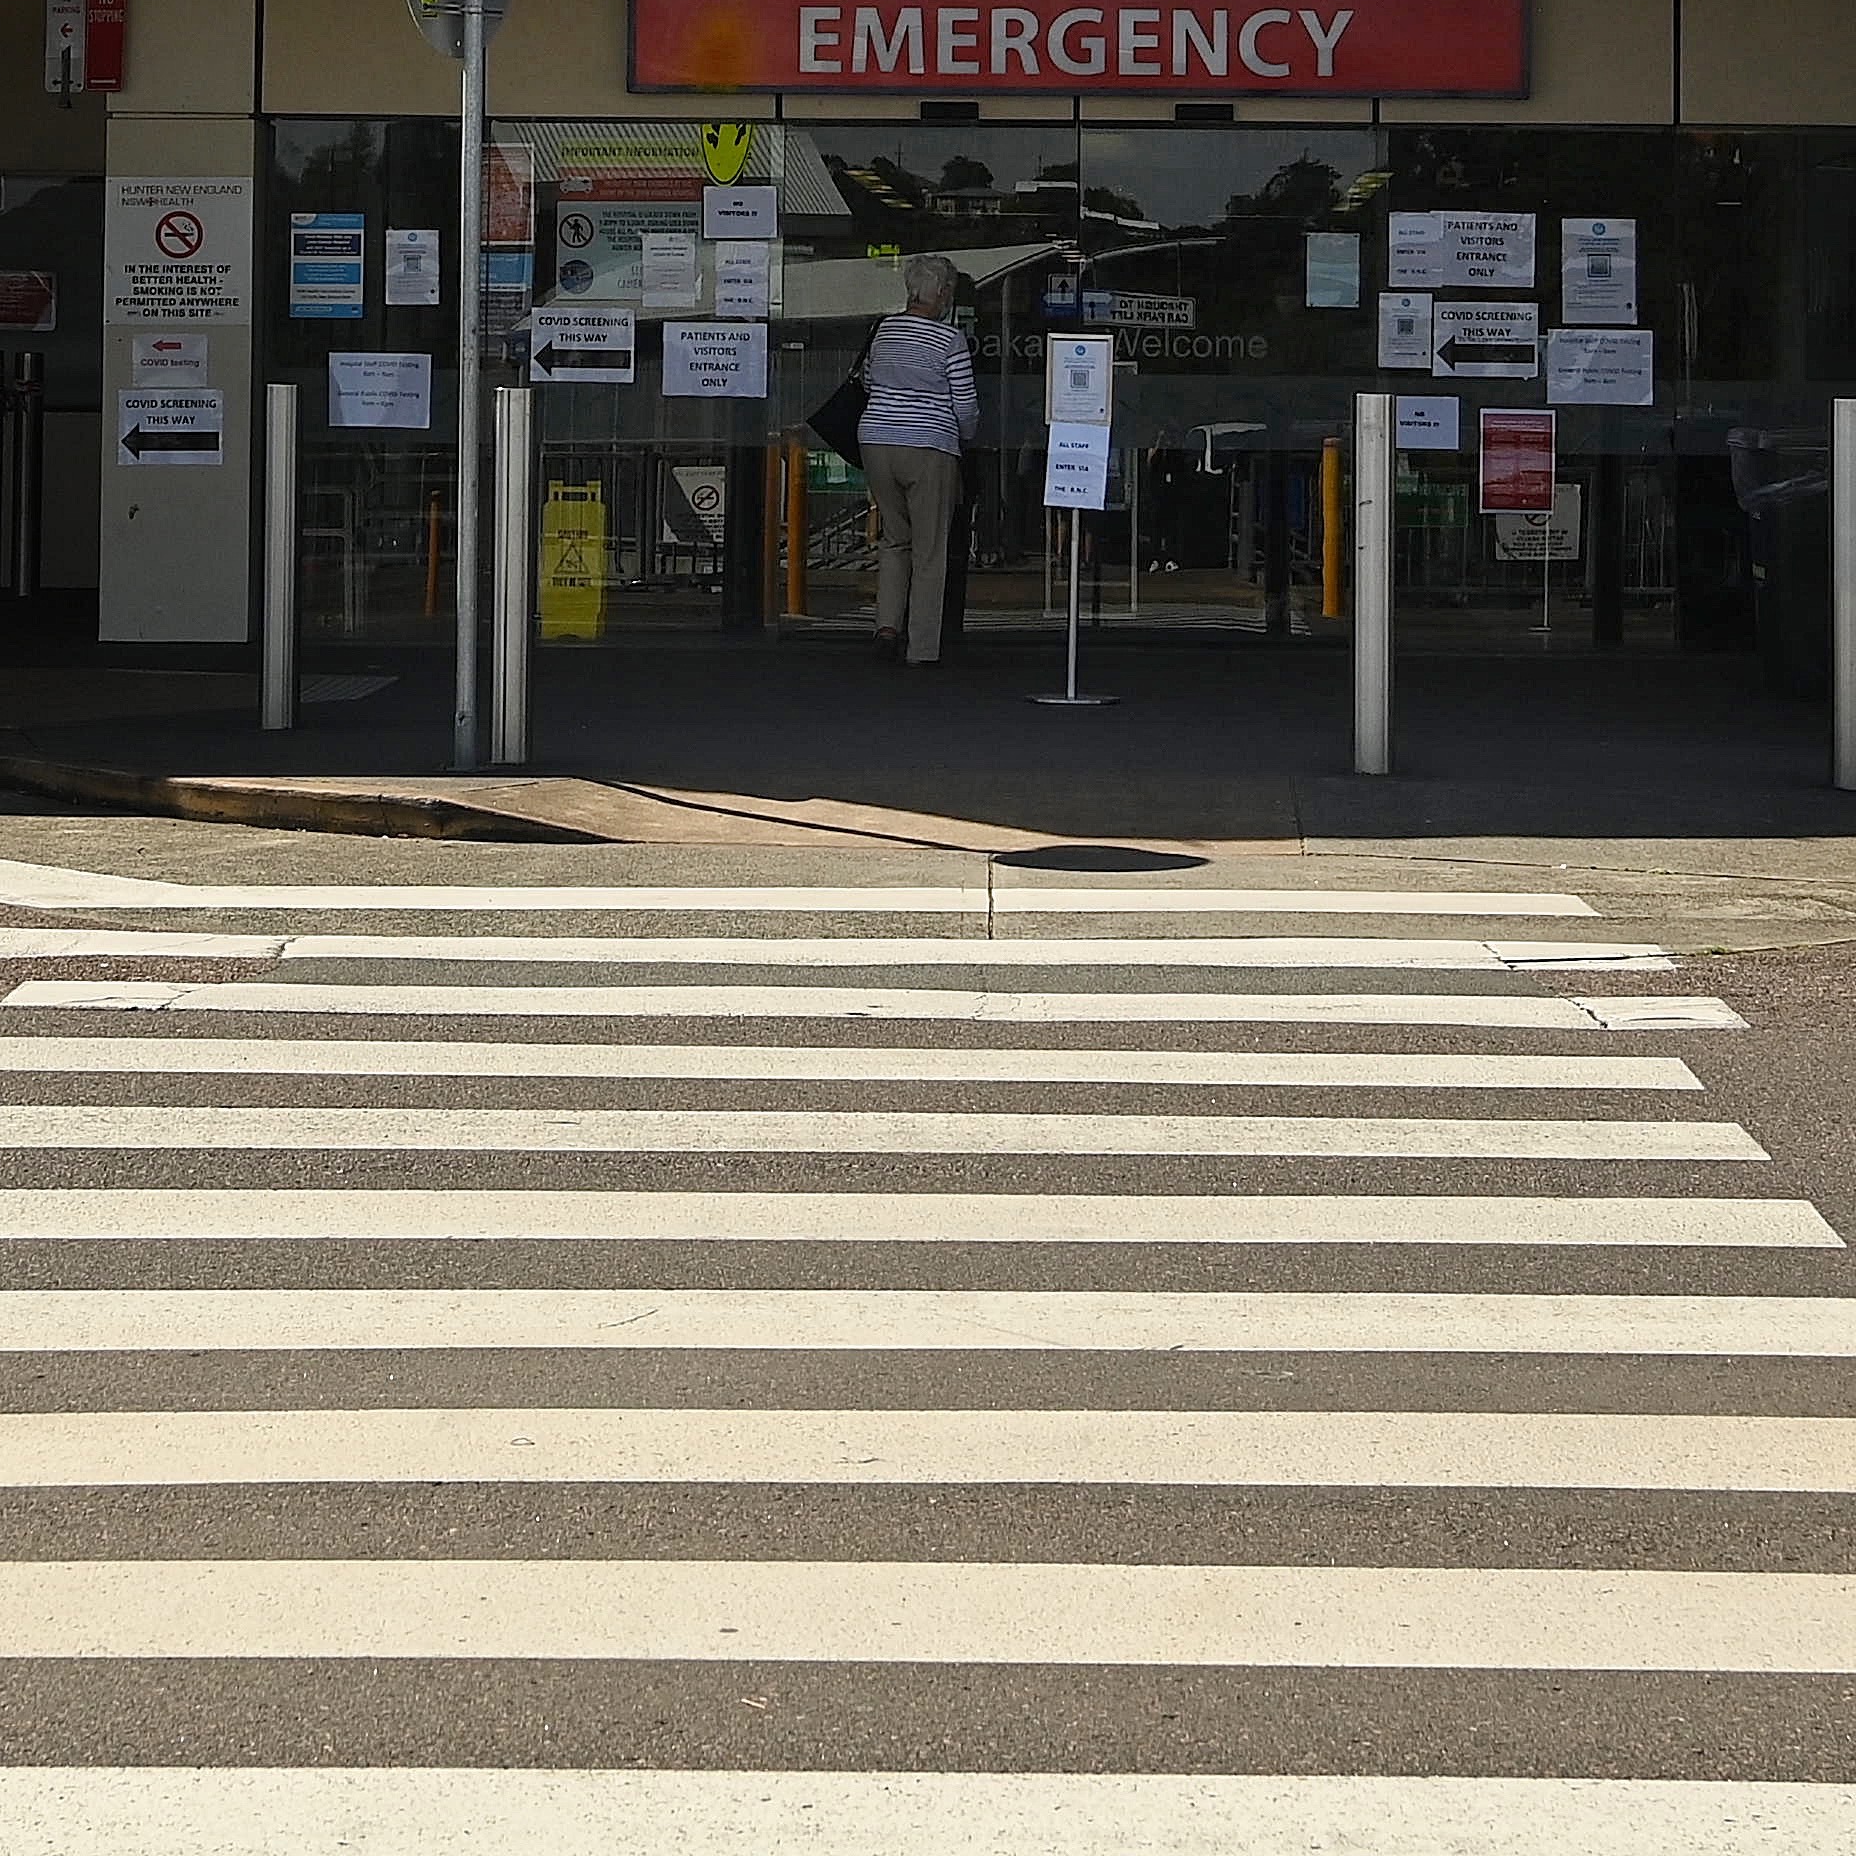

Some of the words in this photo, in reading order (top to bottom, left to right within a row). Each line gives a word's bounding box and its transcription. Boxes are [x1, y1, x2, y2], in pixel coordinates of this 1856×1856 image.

[799, 7, 1355, 77] EMERGENCY
[121, 186, 164, 195] HUNTER
[166, 186, 192, 195] NEW
[193, 186, 243, 195] ENGLAND
[1447, 222, 1494, 231] PATIENTS
[1495, 222, 1518, 231] AND
[1460, 237, 1505, 246] VISITORS
[1456, 252, 1507, 262] ENTRANCE
[124, 264, 136, 274] IN
[138, 264, 160, 274] THE
[162, 264, 215, 274] INTEREST
[216, 264, 232, 274] OF
[1468, 268, 1495, 277] ONLY
[132, 276, 173, 285] BETTER
[176, 276, 217, 285] HEALTH
[132, 286, 184, 296] SMOKING
[186, 286, 197, 296] IS
[199, 286, 223, 296] NOT
[116, 298, 177, 307] PERMITTED
[179, 298, 239, 307] ANYWHERE
[142, 308, 160, 318] ON
[162, 308, 186, 318] THIS
[188, 308, 212, 318] SITE
[1441, 312, 1474, 321] COVID
[1476, 312, 1532, 321] SCREENING
[538, 317, 571, 327] COVID
[572, 317, 629, 327] SCREENING
[680, 332, 726, 341] PATIENTS
[728, 332, 750, 341] AND
[1462, 328, 1485, 336] THIS
[1486, 328, 1512, 336] WAY
[559, 333, 583, 342] THIS
[584, 333, 608, 342] WAY
[1114, 328, 1269, 359] Welcome
[694, 347, 737, 356] VISITORS
[140, 358, 169, 367] COVID
[170, 358, 200, 368] testing
[689, 362, 741, 372] ENTRANCE
[701, 378, 728, 387] ONLY
[125, 399, 158, 409] COVID
[160, 399, 217, 409] SCREENING
[146, 416, 170, 425] THIS
[171, 416, 196, 425] WAY
